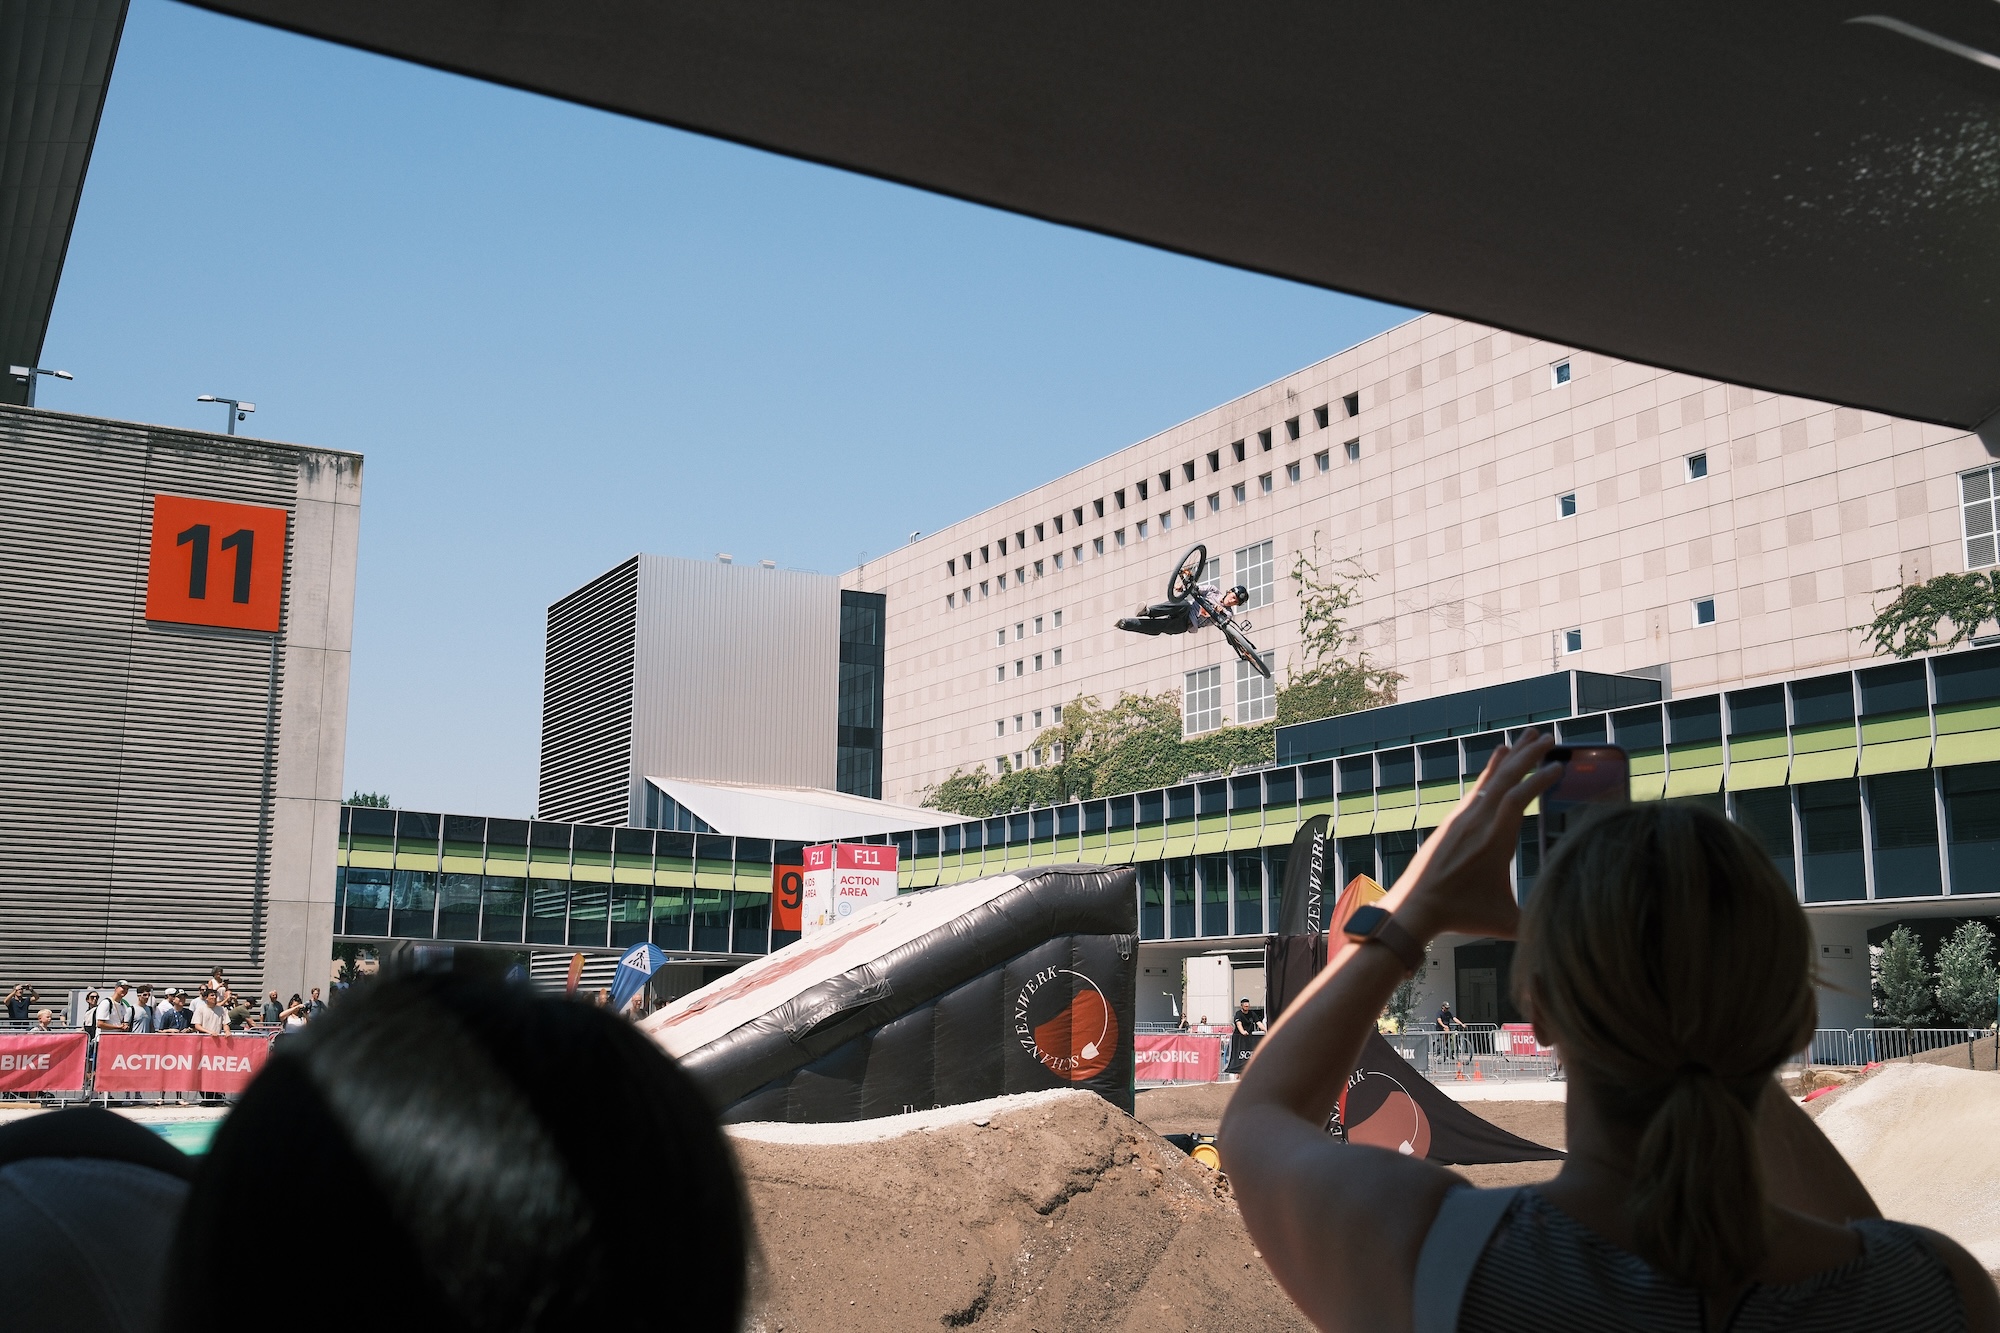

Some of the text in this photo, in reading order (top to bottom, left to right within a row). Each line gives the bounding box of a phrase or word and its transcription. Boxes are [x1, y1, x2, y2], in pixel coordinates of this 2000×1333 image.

[176, 523, 255, 604] 11
[810, 850, 824, 866] F11
[854, 849, 881, 865] F11
[804, 877, 815, 887] KIDS
[840, 876, 880, 886] ACTION
[781, 872, 803, 909] 9
[804, 889, 817, 898] AREA
[840, 887, 868, 897] AREA
[1014, 964, 1080, 1071] SCHANZENWERK
[0, 1053, 51, 1071] BIKE
[111, 1053, 252, 1073] ACTION AREA
[1135, 1050, 1200, 1064] EUROBIKE
